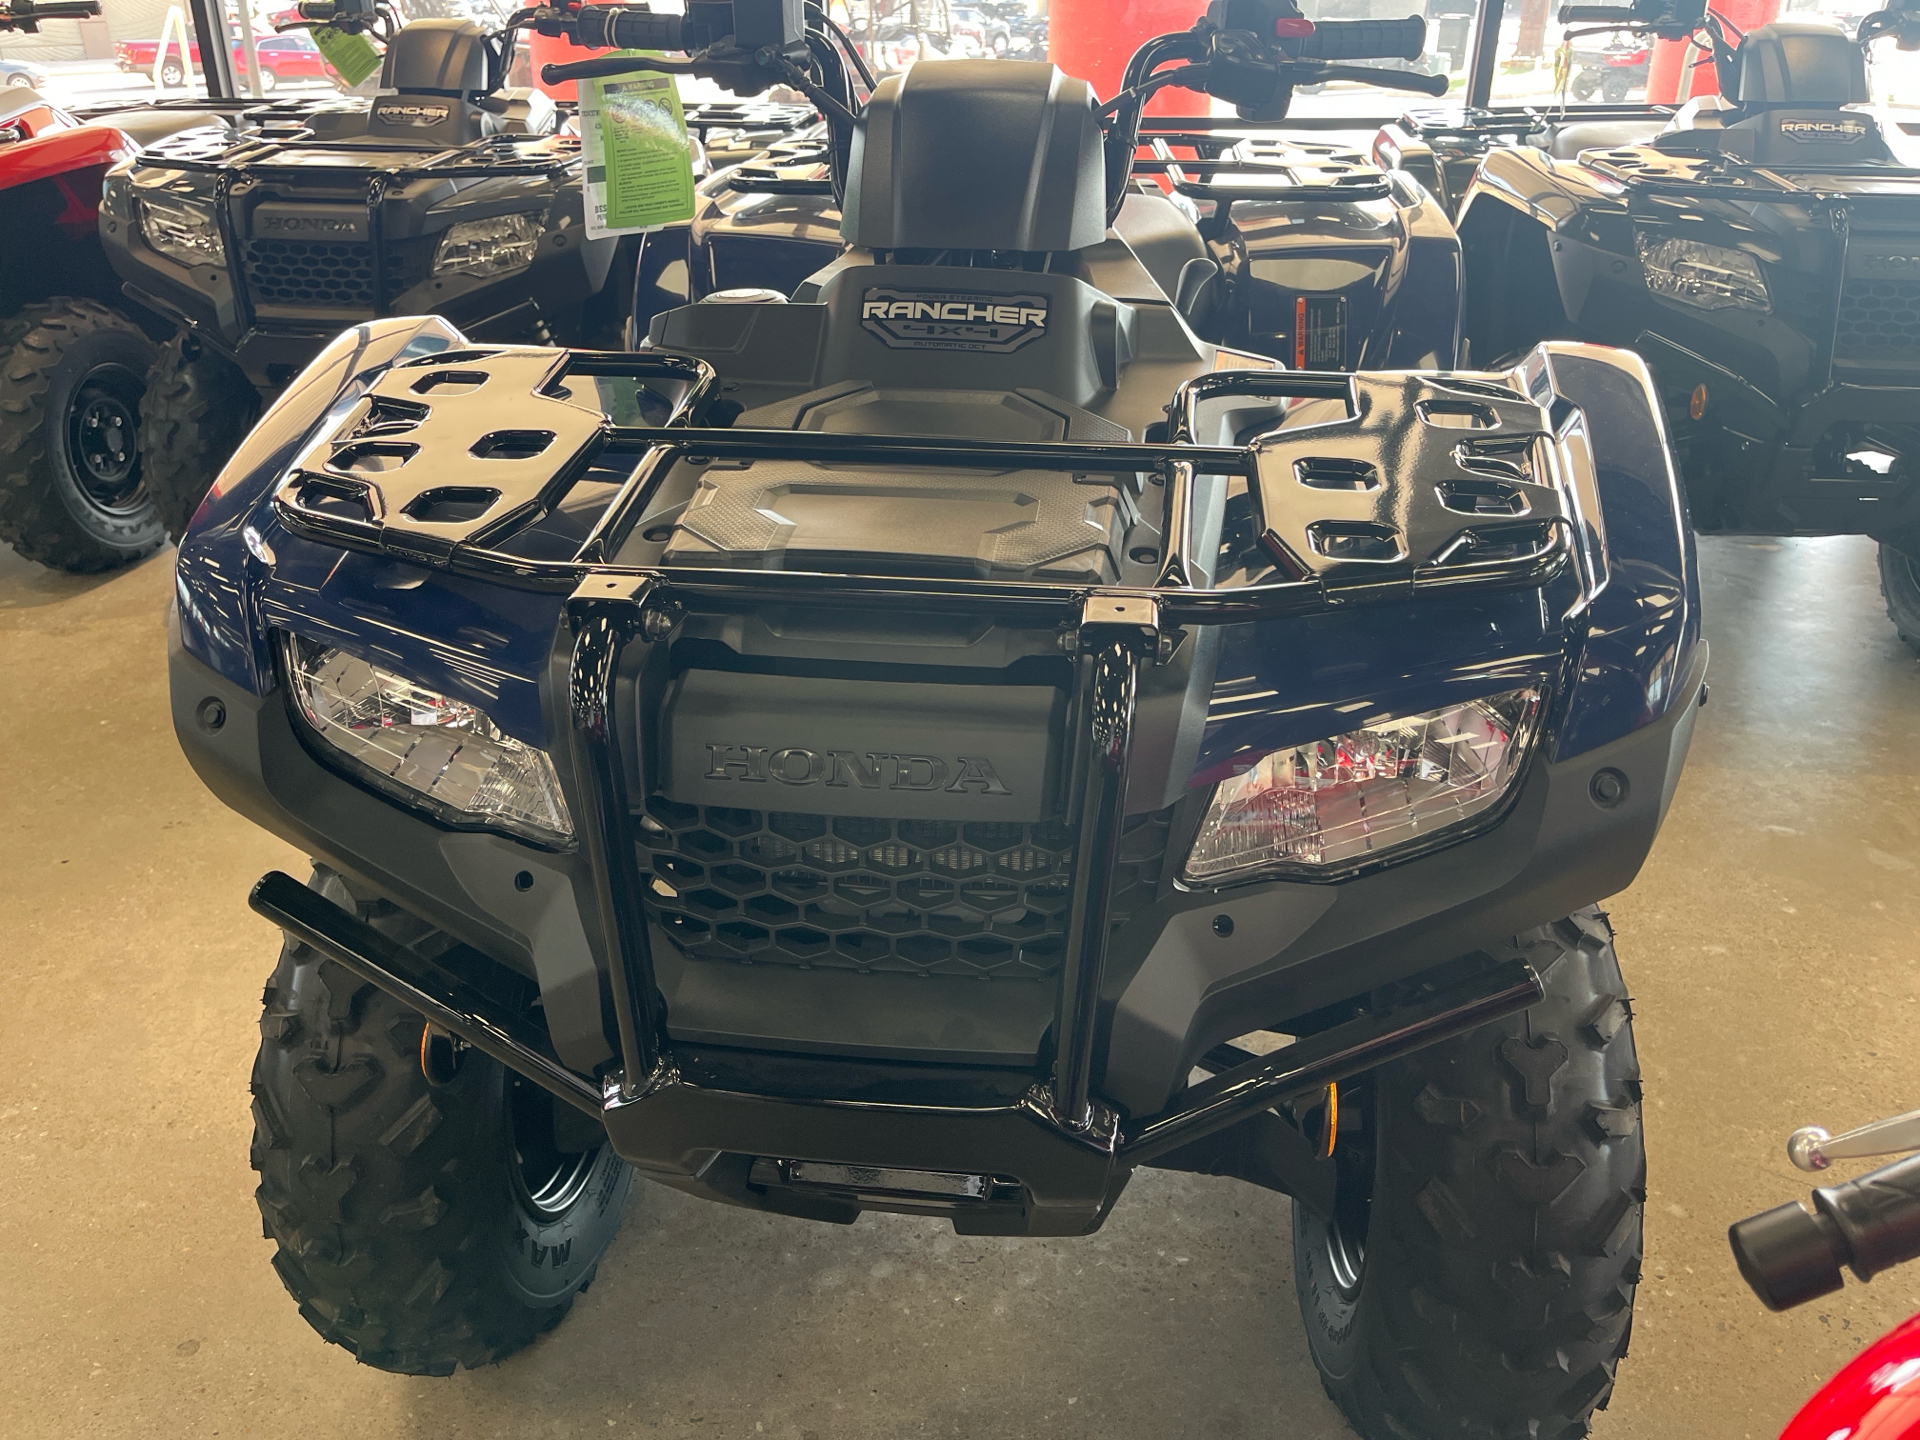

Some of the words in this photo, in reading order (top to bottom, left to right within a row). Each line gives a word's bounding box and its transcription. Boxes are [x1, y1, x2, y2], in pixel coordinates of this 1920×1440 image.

[377, 106, 449, 118] RANCHER
[1781, 123, 1866, 134] RANCHER
[264, 217, 357, 232] HONDA
[949, 294, 993, 302] STEERING
[862, 301, 1047, 327] RANCHER
[914, 341, 967, 349] AUTOMATIC
[704, 743, 1012, 795] HONDA
